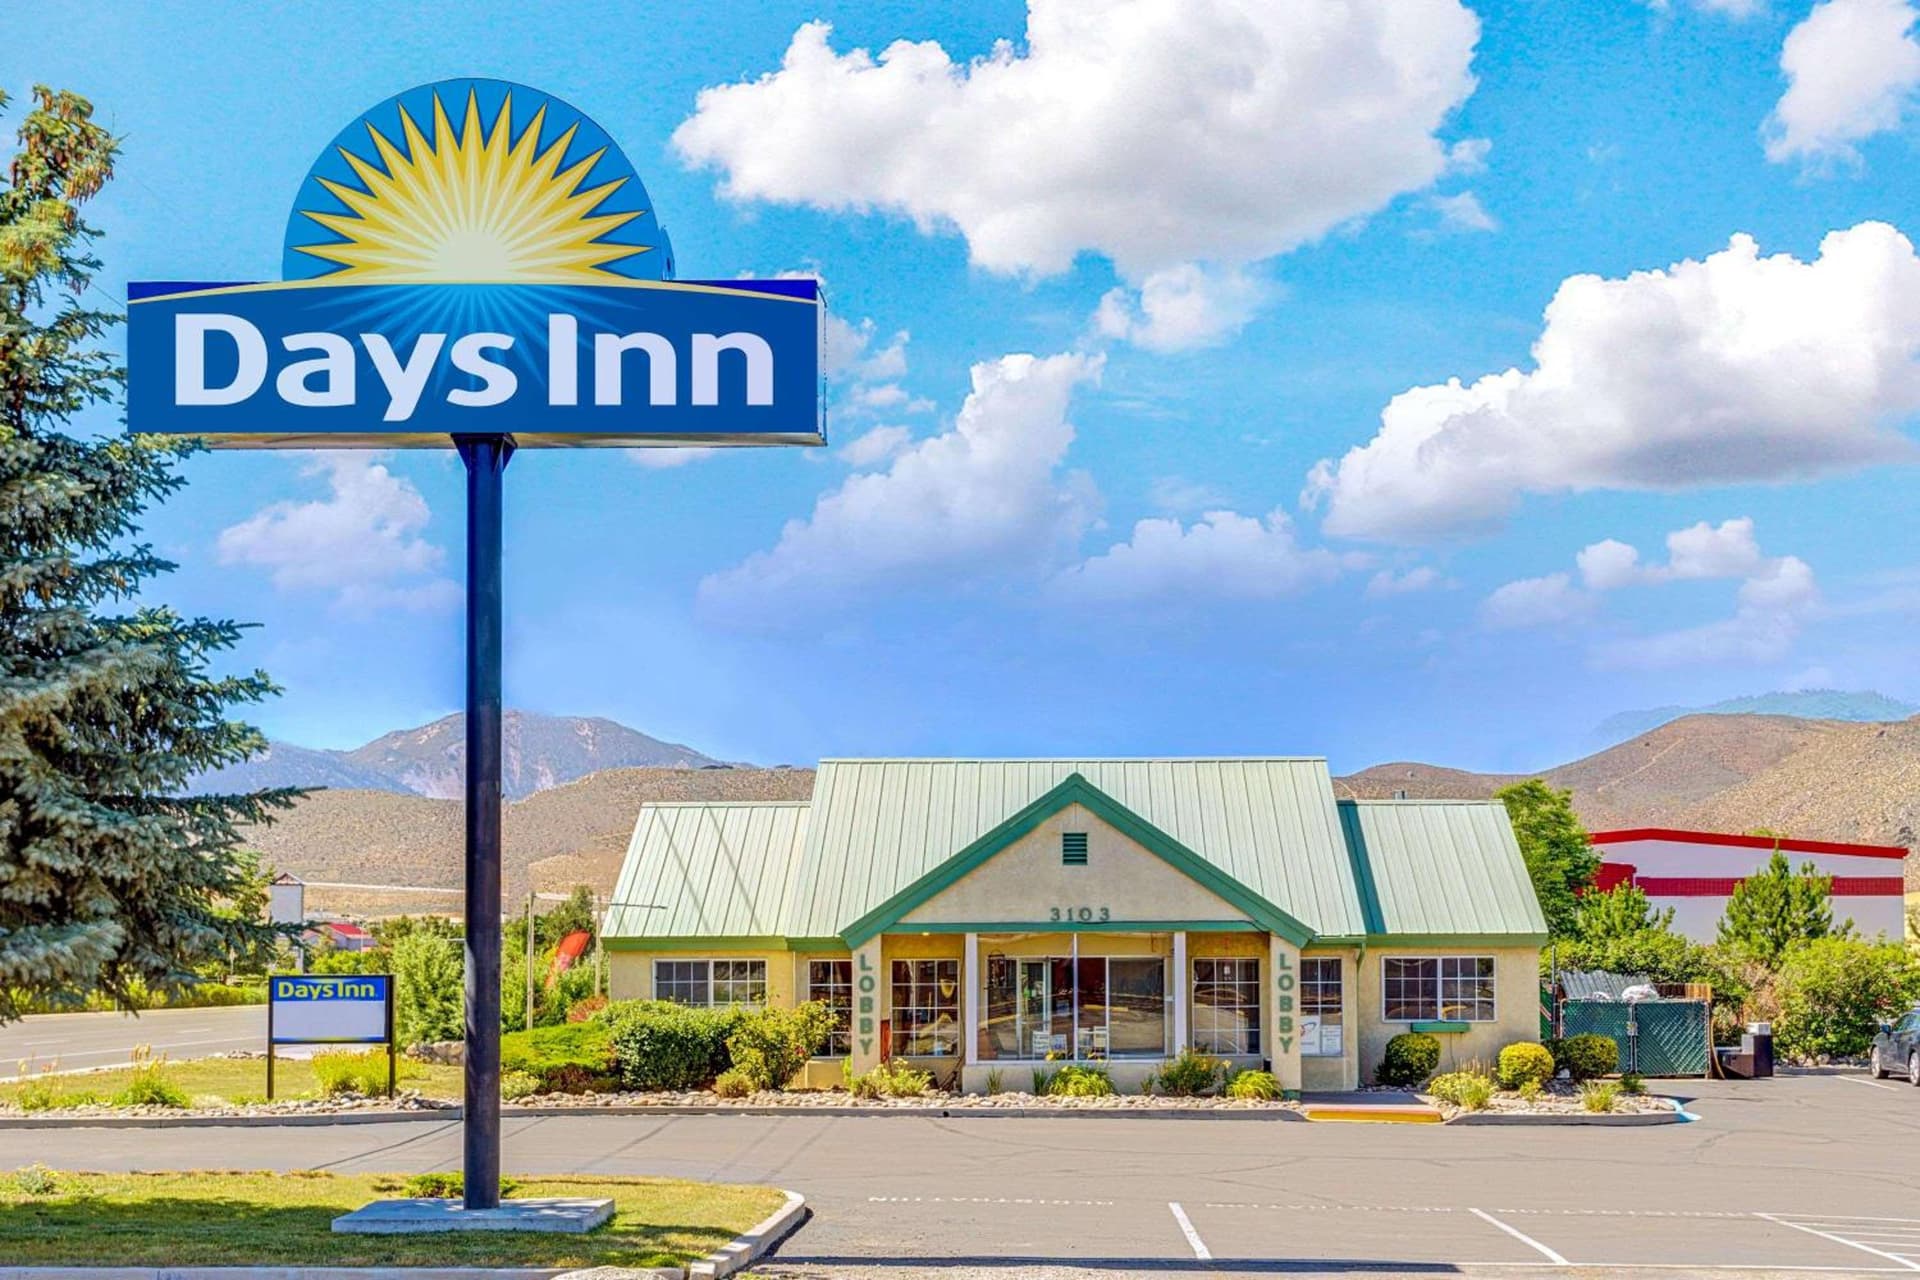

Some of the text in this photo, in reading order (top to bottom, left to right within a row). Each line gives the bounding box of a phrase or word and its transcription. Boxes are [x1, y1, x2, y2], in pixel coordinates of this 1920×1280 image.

[175, 313, 774, 421] Days Inn
[1050, 906, 1111, 921] 3103
[278, 981, 375, 1000] Days Inn
[859, 953, 876, 1056] LOBBY
[1278, 952, 1295, 1054] LOBBY
